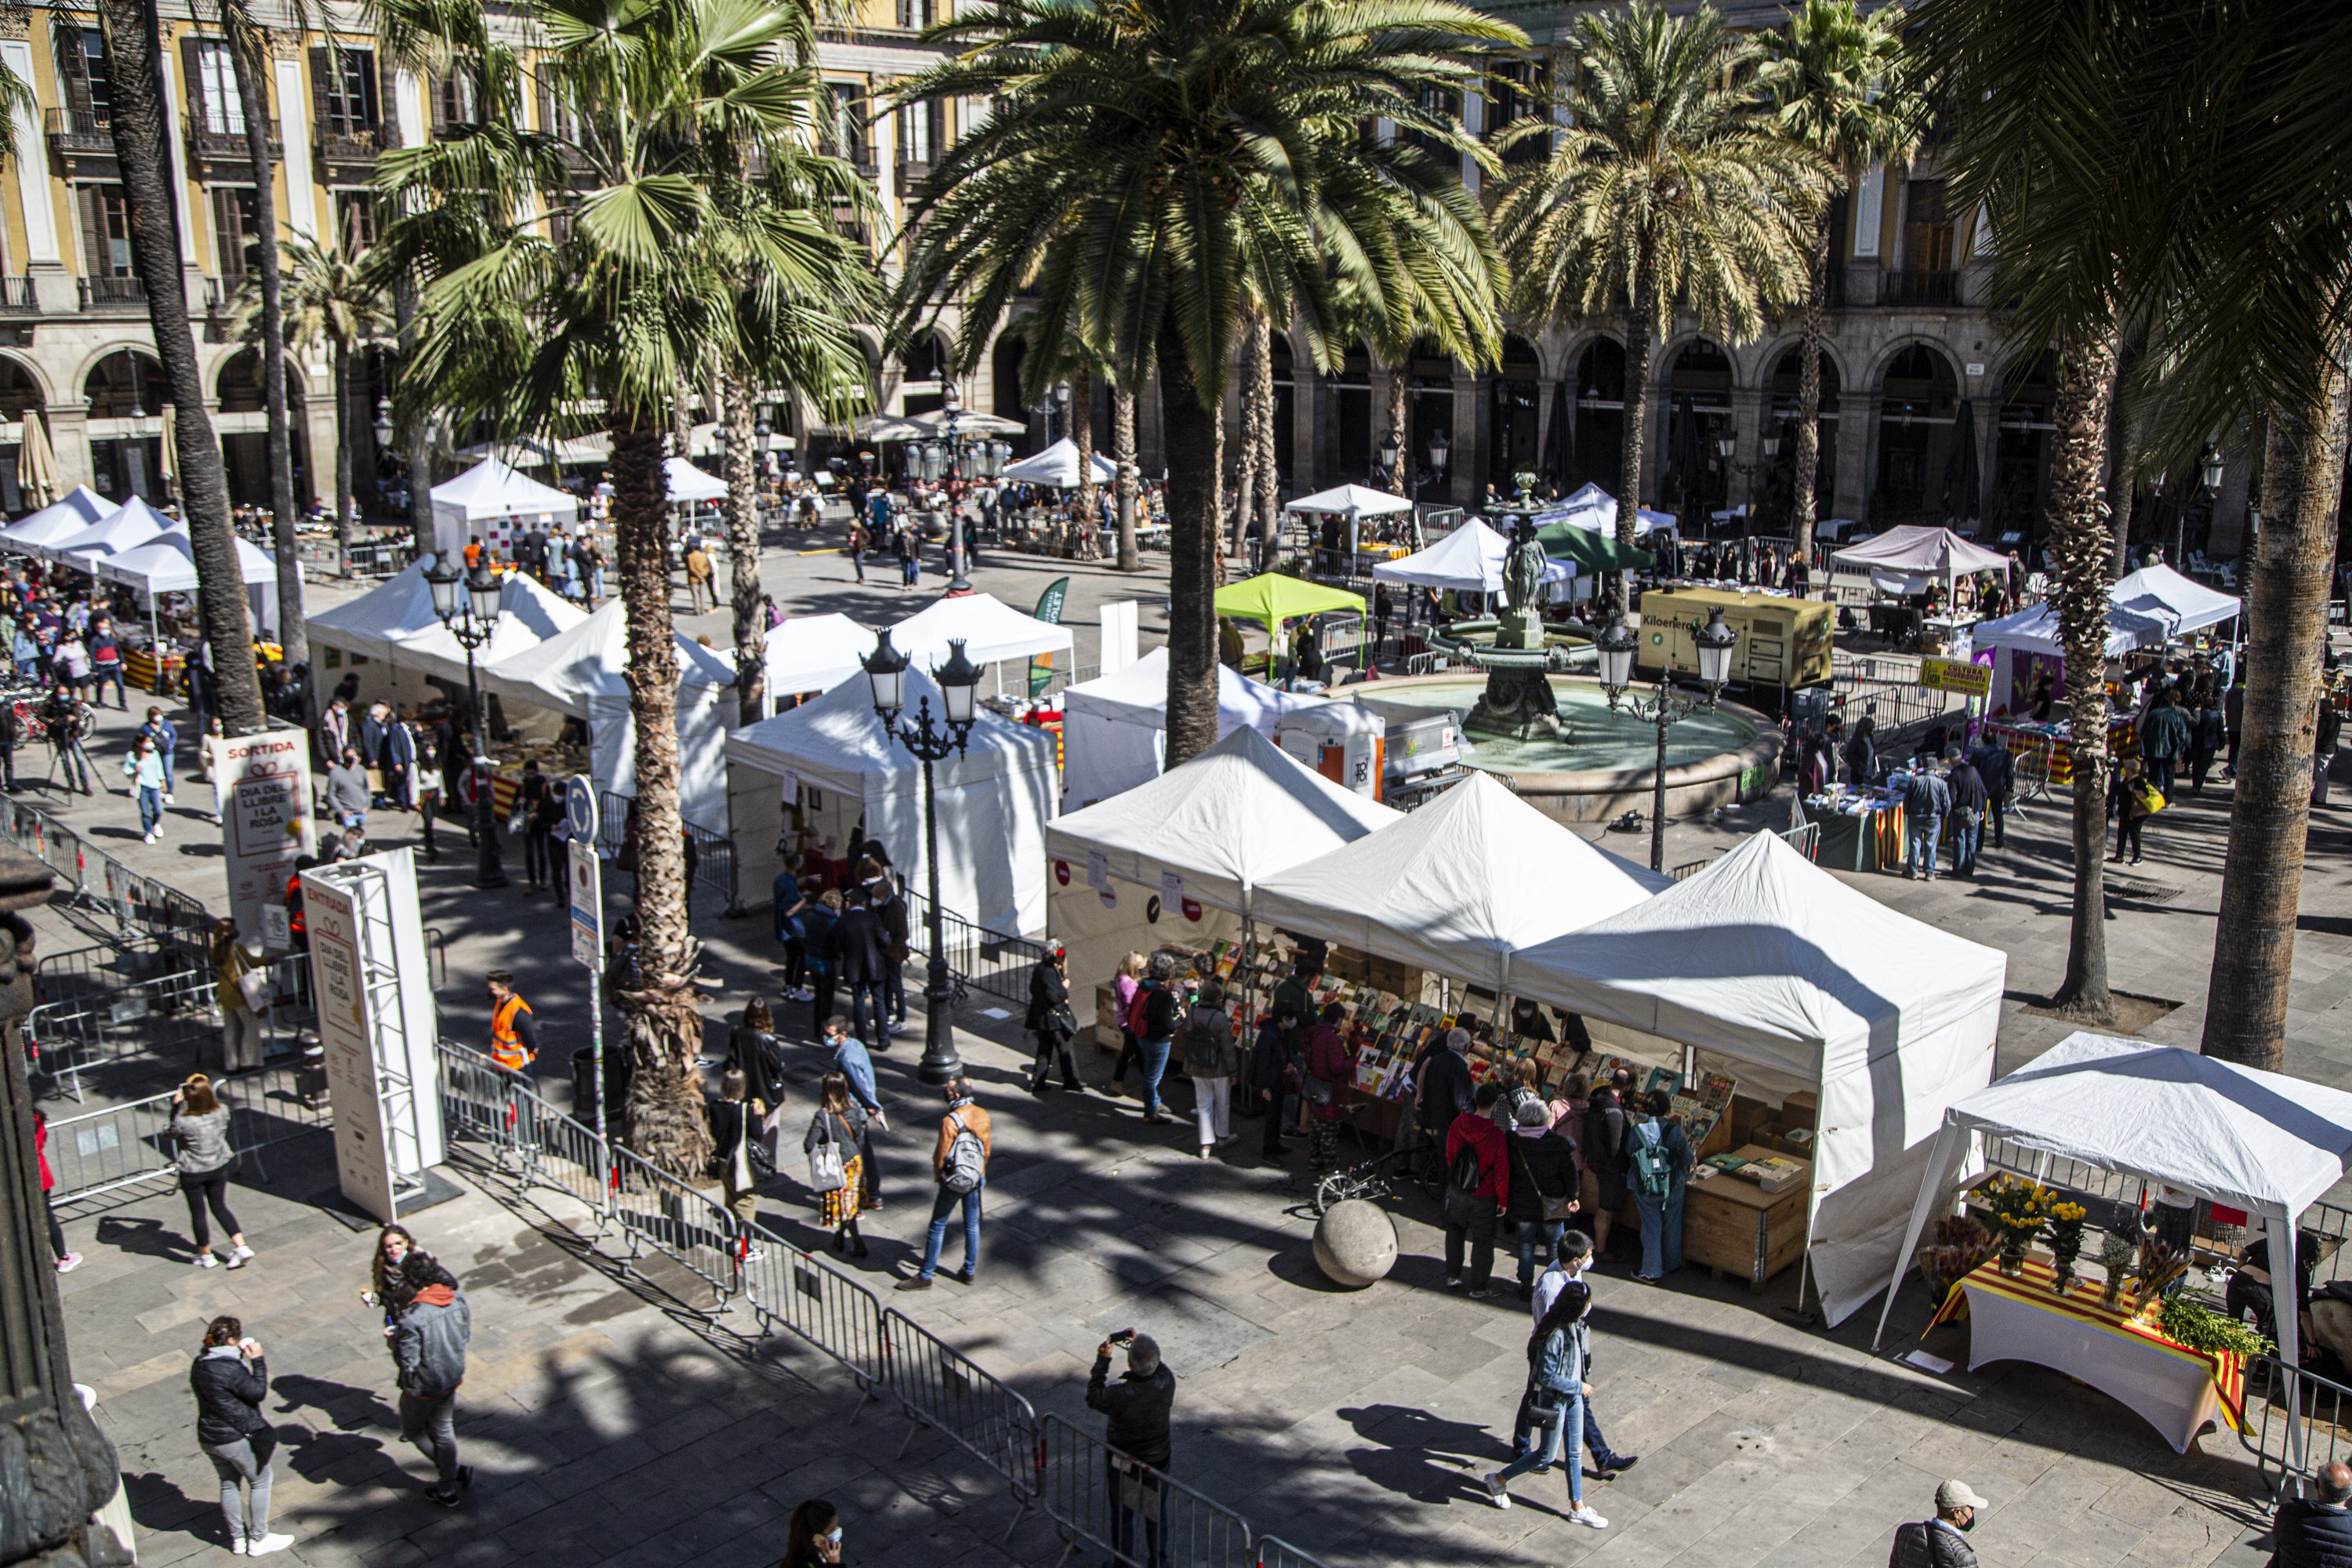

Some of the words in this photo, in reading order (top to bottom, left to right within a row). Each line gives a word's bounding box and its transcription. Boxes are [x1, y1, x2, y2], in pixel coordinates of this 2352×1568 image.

[1051, 591, 1062, 623] IOLET
[1948, 664, 1983, 675] CULTURA
[228, 741, 295, 759] SORTIDA
[240, 786, 261, 798] DIA
[263, 784, 288, 794] DEL
[243, 793, 287, 808] LLIBRE
[261, 806, 277, 815] LA
[249, 816, 284, 829] ROSA
[307, 887, 351, 916] ENTRADA
[333, 946, 349, 964] DEL
[322, 954, 350, 977] LLIBRE
[328, 983, 350, 1002] ROSA
